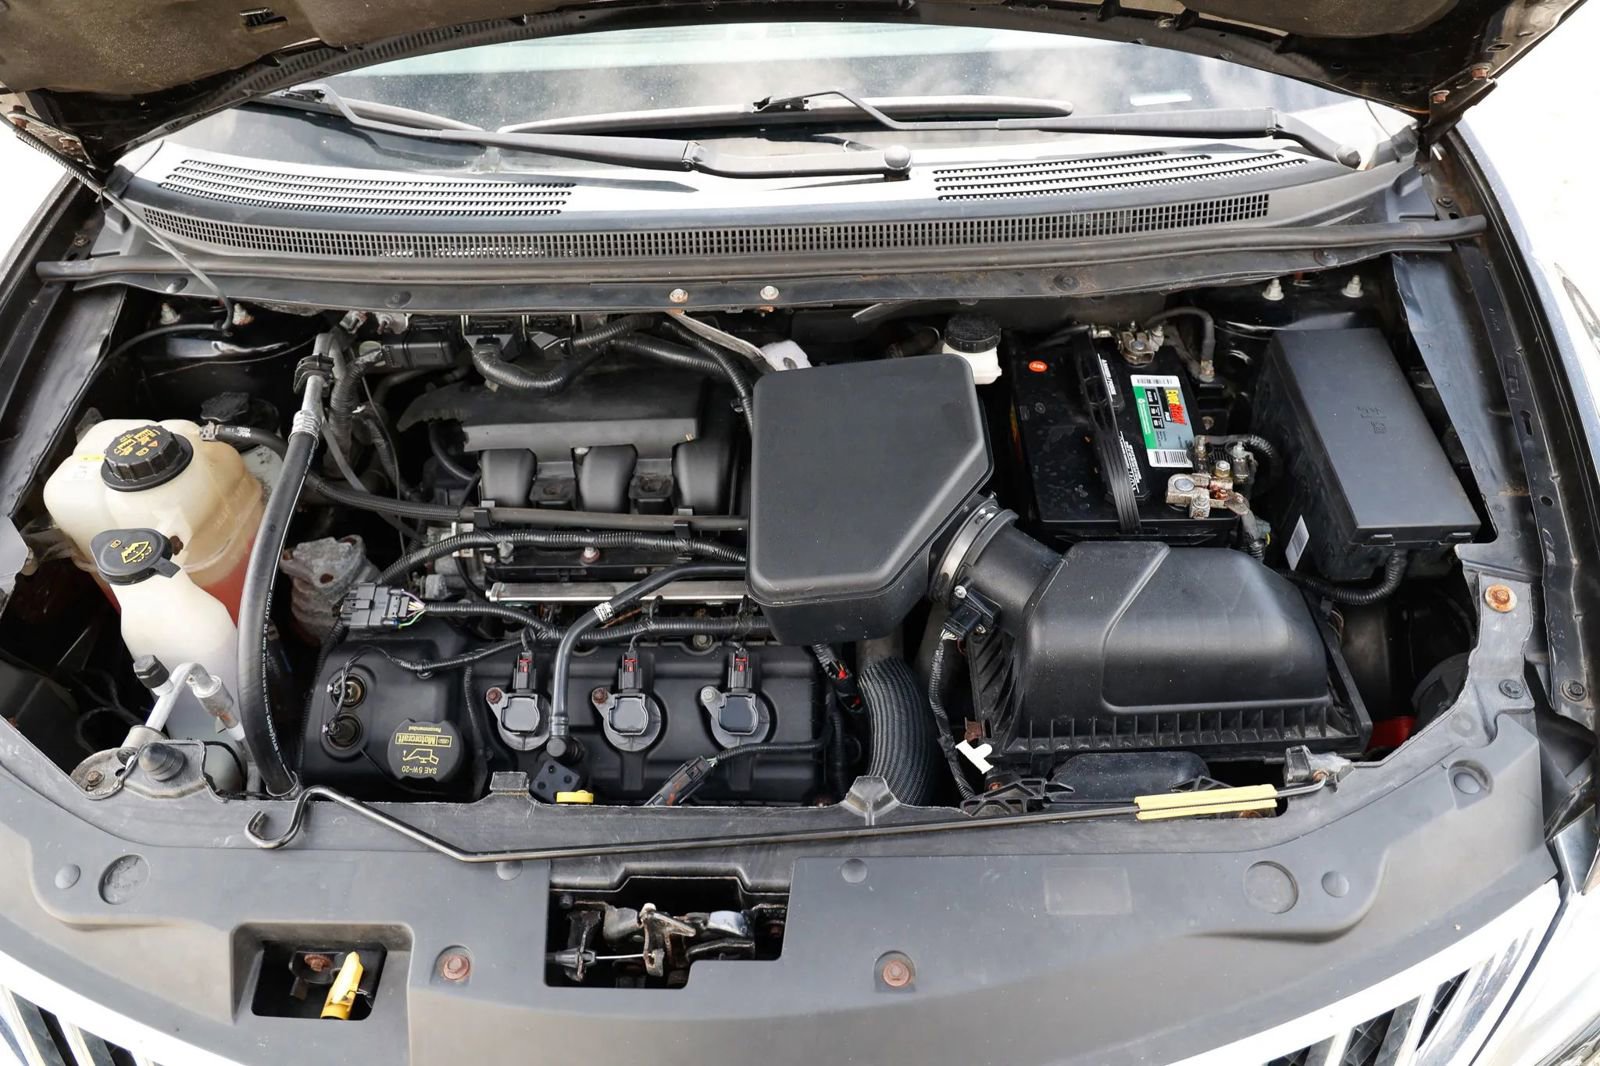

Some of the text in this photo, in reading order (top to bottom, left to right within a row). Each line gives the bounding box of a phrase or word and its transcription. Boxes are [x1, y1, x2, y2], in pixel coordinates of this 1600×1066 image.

[398, 735, 436, 745] Motorcraft
[402, 766, 437, 775] SAE 5W-20
